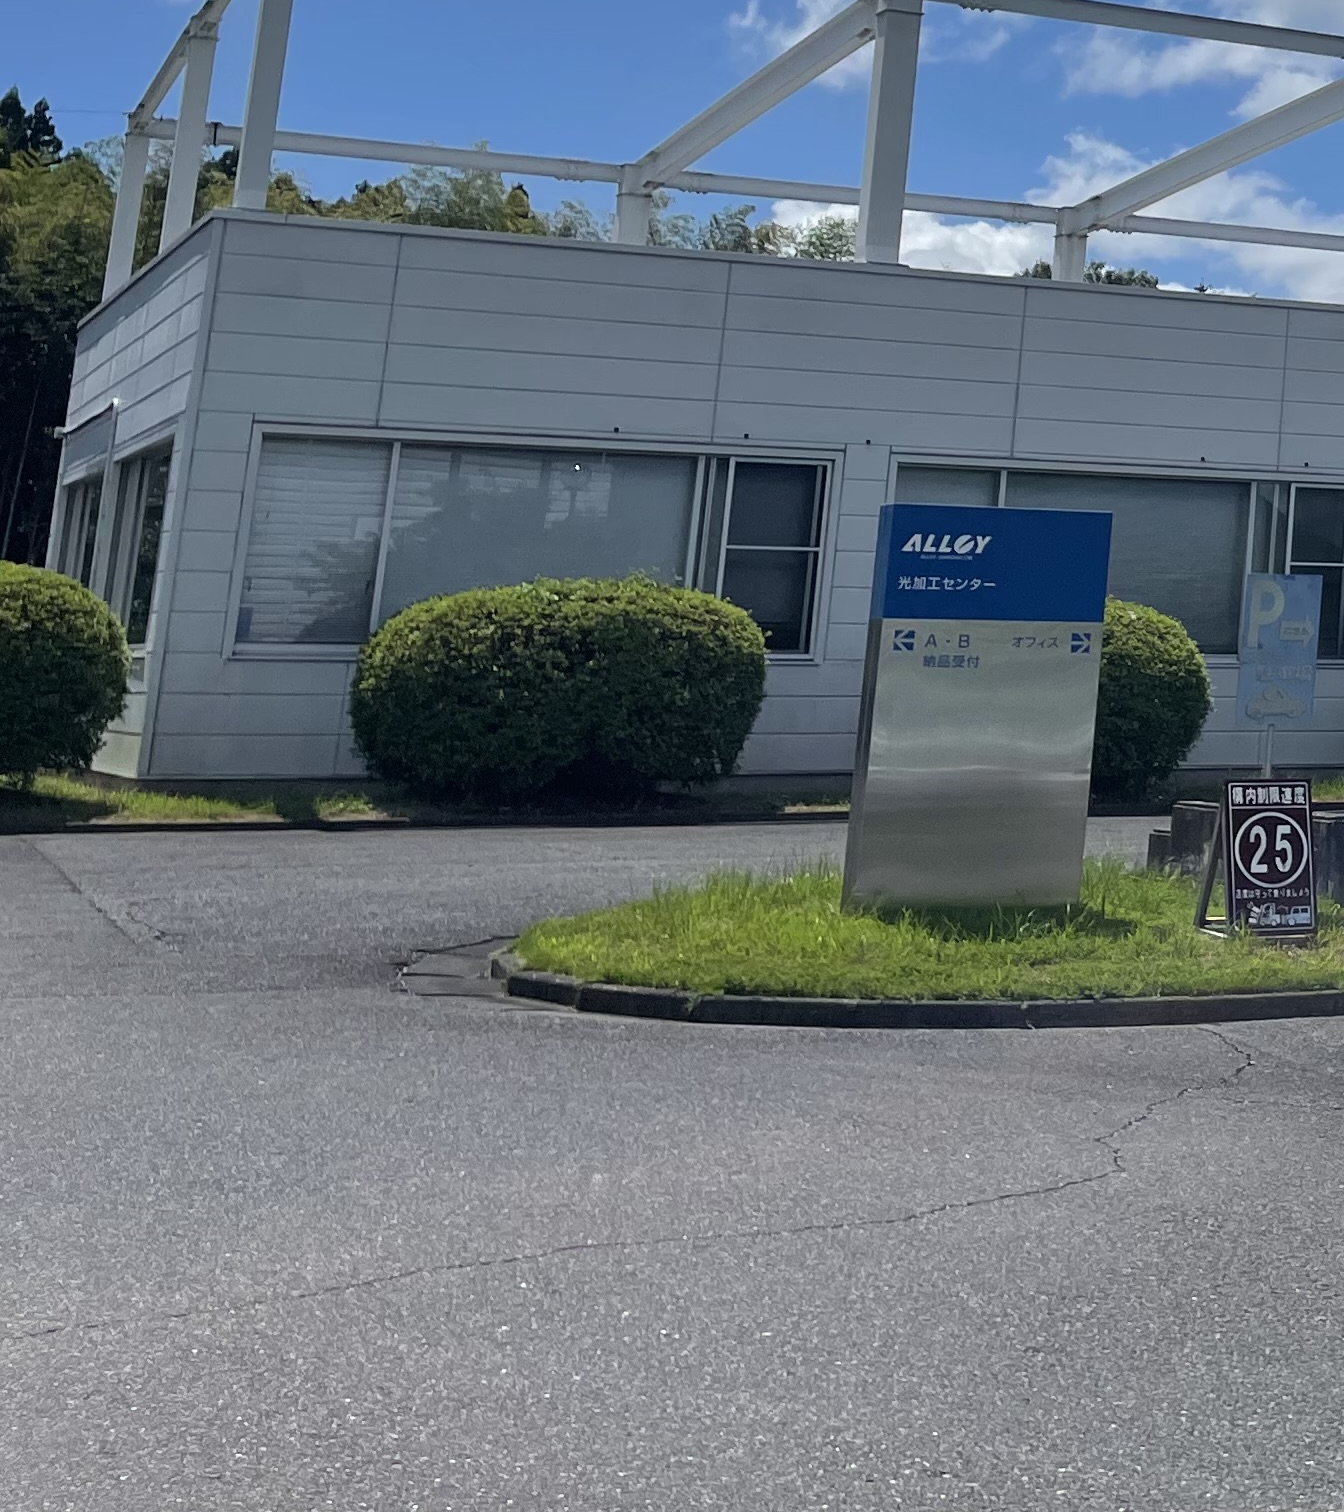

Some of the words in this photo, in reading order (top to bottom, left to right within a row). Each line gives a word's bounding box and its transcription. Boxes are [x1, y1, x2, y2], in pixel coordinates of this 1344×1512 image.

[901, 534, 992, 554] ALLOY
[898, 576, 996, 591] 光加工センター
[1247, 580, 1285, 648] P
[1011, 636, 1060, 649] オフィス
[922, 655, 980, 669] 納品受付
[1232, 786, 1306, 805] 構内制限速度
[1249, 824, 1293, 873] 25
